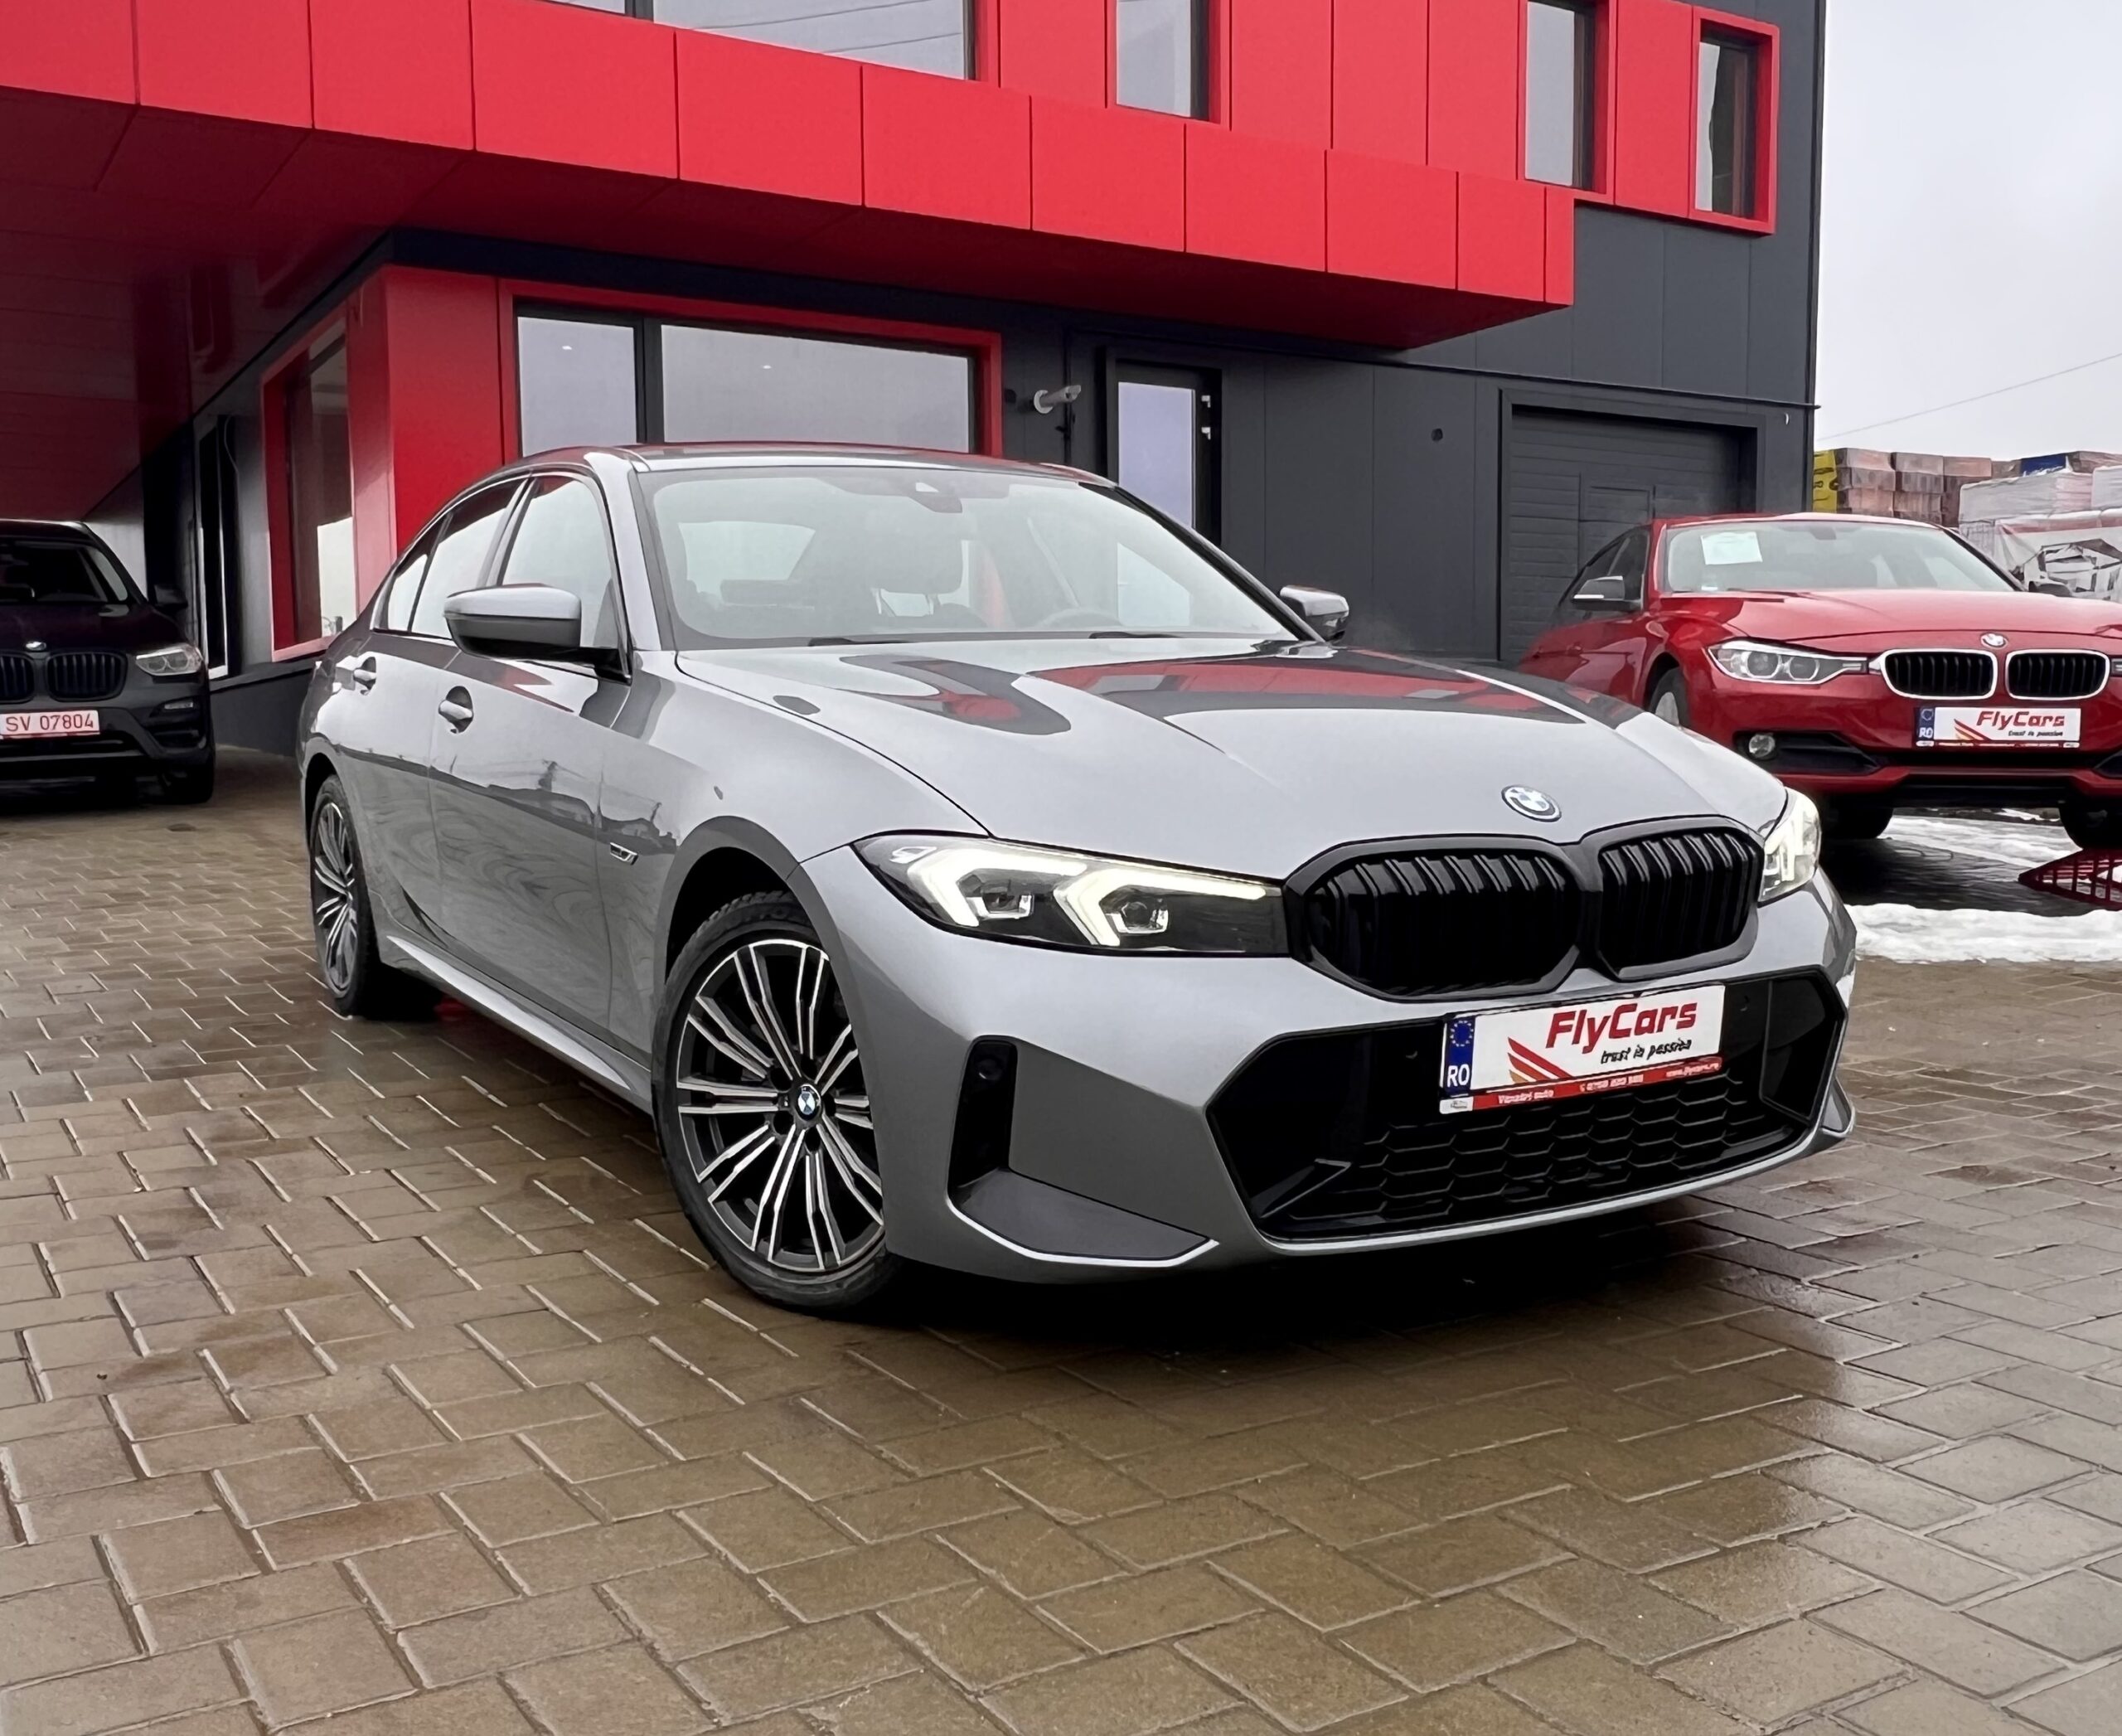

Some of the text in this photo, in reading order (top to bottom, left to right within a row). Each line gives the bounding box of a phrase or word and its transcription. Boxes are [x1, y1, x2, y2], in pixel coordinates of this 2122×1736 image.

[5, 713, 94, 731] SV 07804
[1976, 710, 2065, 730] FlyCars
[1919, 727, 1934, 739] RO
[1546, 1002, 1698, 1055] FlyCars
[1446, 1064, 1470, 1088] RO
